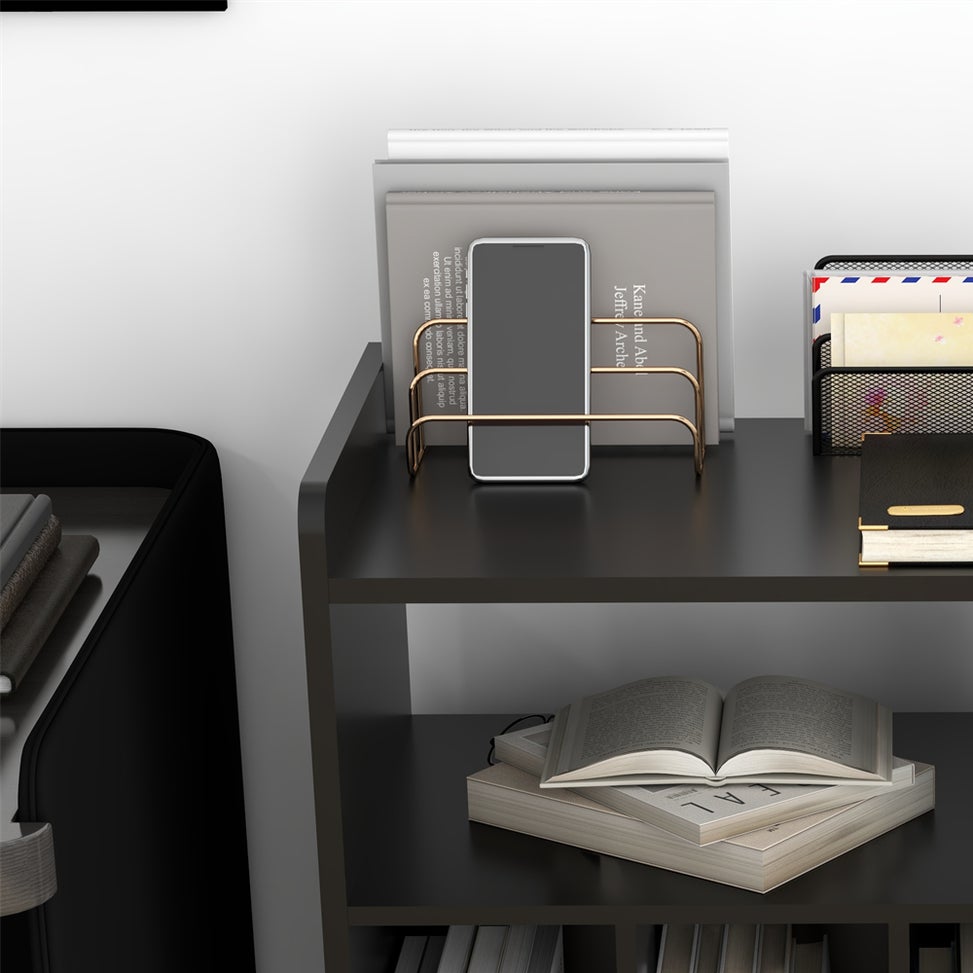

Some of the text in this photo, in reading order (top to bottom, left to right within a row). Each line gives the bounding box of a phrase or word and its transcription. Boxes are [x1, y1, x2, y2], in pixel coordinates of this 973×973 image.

[433, 251, 442, 296] exercitation
[444, 257, 452, 266] Ut
[454, 247, 464, 284] incididunt
[423, 278, 430, 288] ex
[444, 267, 452, 286] enim
[424, 290, 431, 300] ea
[445, 288, 453, 298] ad
[632, 284, 646, 317] Kane
[424, 301, 433, 340] comodo
[434, 298, 443, 328] ullamo
[446, 300, 454, 319] mini
[436, 330, 444, 356] laboris
[634, 323, 648, 342] nd
[615, 330, 629, 368] Arche
[458, 358, 466, 384] mana
[448, 376, 456, 405] nostrud
